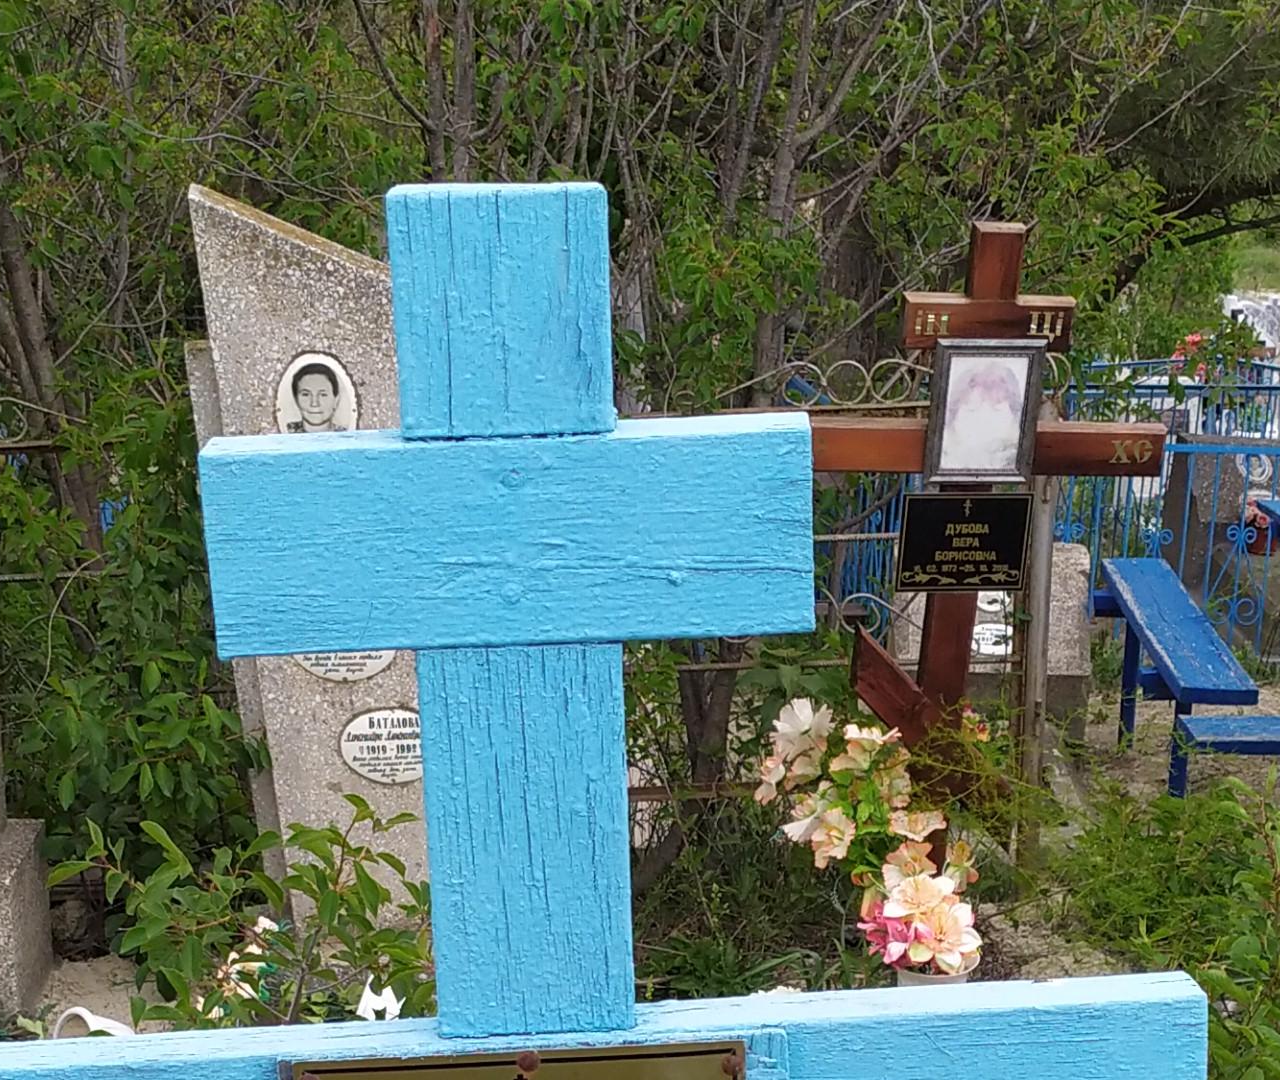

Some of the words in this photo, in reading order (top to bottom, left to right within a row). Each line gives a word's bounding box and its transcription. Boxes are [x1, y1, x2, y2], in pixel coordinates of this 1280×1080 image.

[945, 523, 990, 536] ДУБОВА
[952, 537, 980, 548] ВЕРА
[934, 550, 997, 561] БОРИСОВНА
